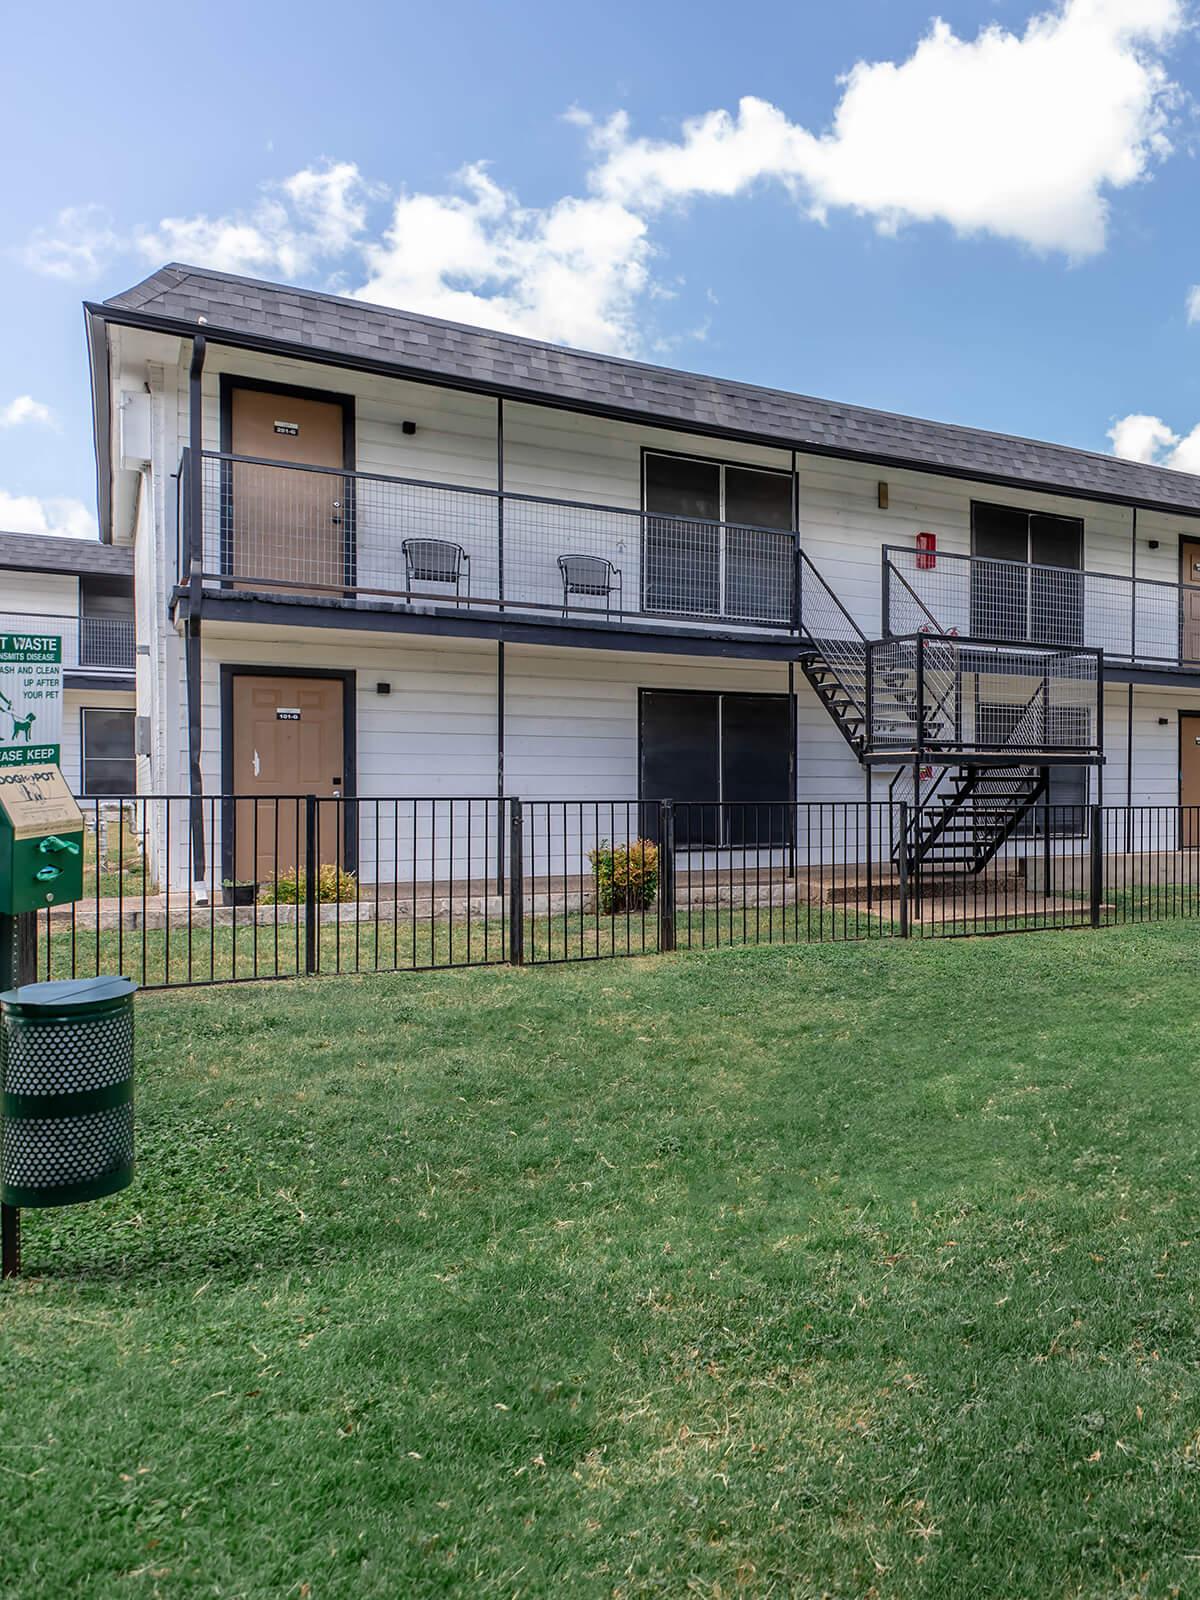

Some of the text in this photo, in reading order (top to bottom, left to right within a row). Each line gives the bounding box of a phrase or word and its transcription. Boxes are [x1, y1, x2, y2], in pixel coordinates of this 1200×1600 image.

[13, 637, 57, 651] WASTE
[27, 653, 55, 661] DISEASE
[18, 666, 33, 675] AND
[36, 666, 59, 675] CLEAN
[24, 678, 59, 687] UP AFTER
[23, 690, 59, 699] YOUR PET
[0, 748, 55, 762] ASE KEEP
